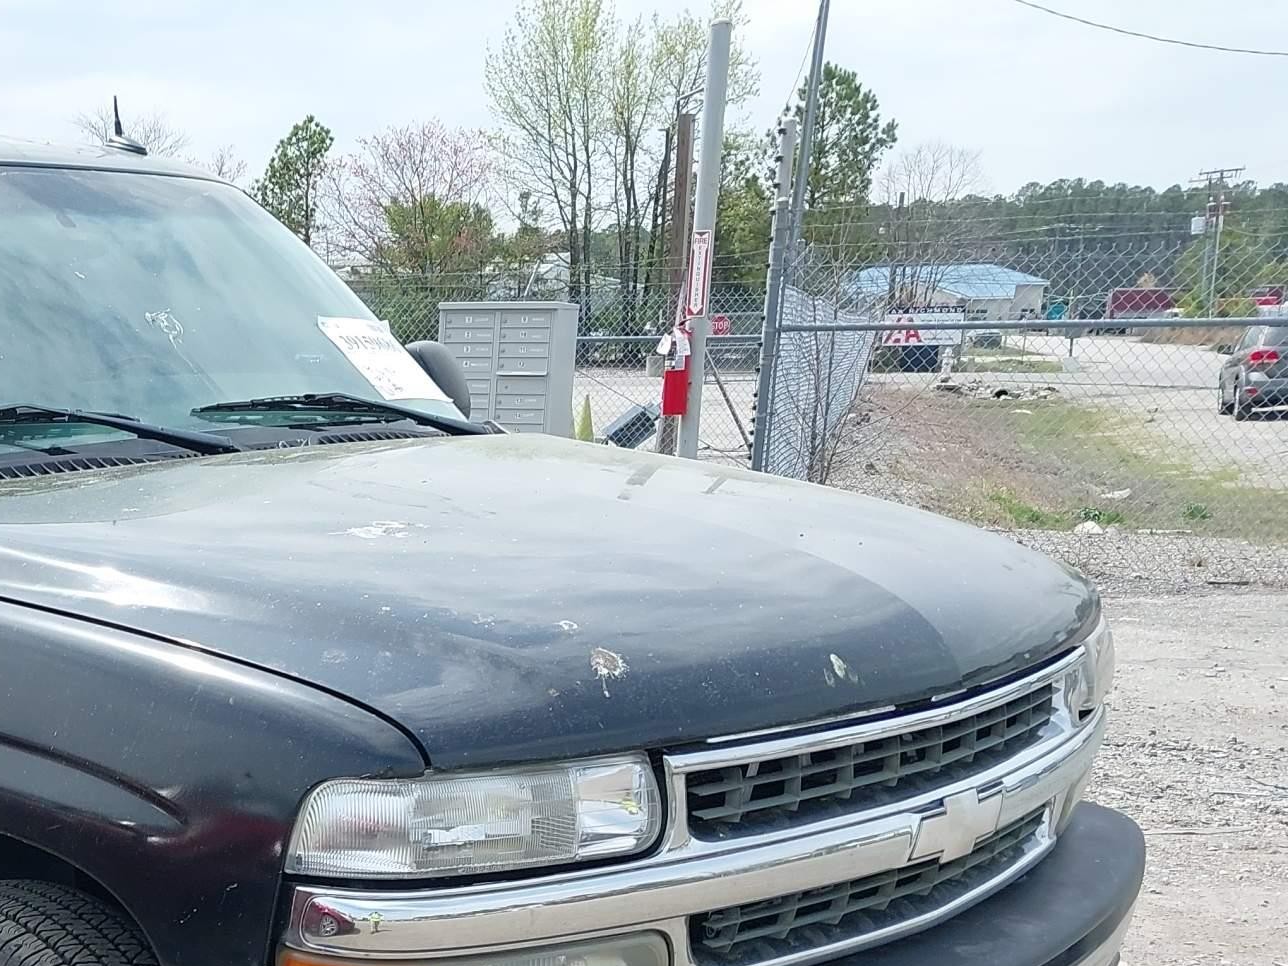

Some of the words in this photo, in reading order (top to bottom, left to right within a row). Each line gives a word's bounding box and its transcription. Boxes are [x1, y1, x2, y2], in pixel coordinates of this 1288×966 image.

[695, 237, 708, 245] FIRE
[908, 306, 963, 314] RICHMOND
[712, 321, 728, 330] STOP
